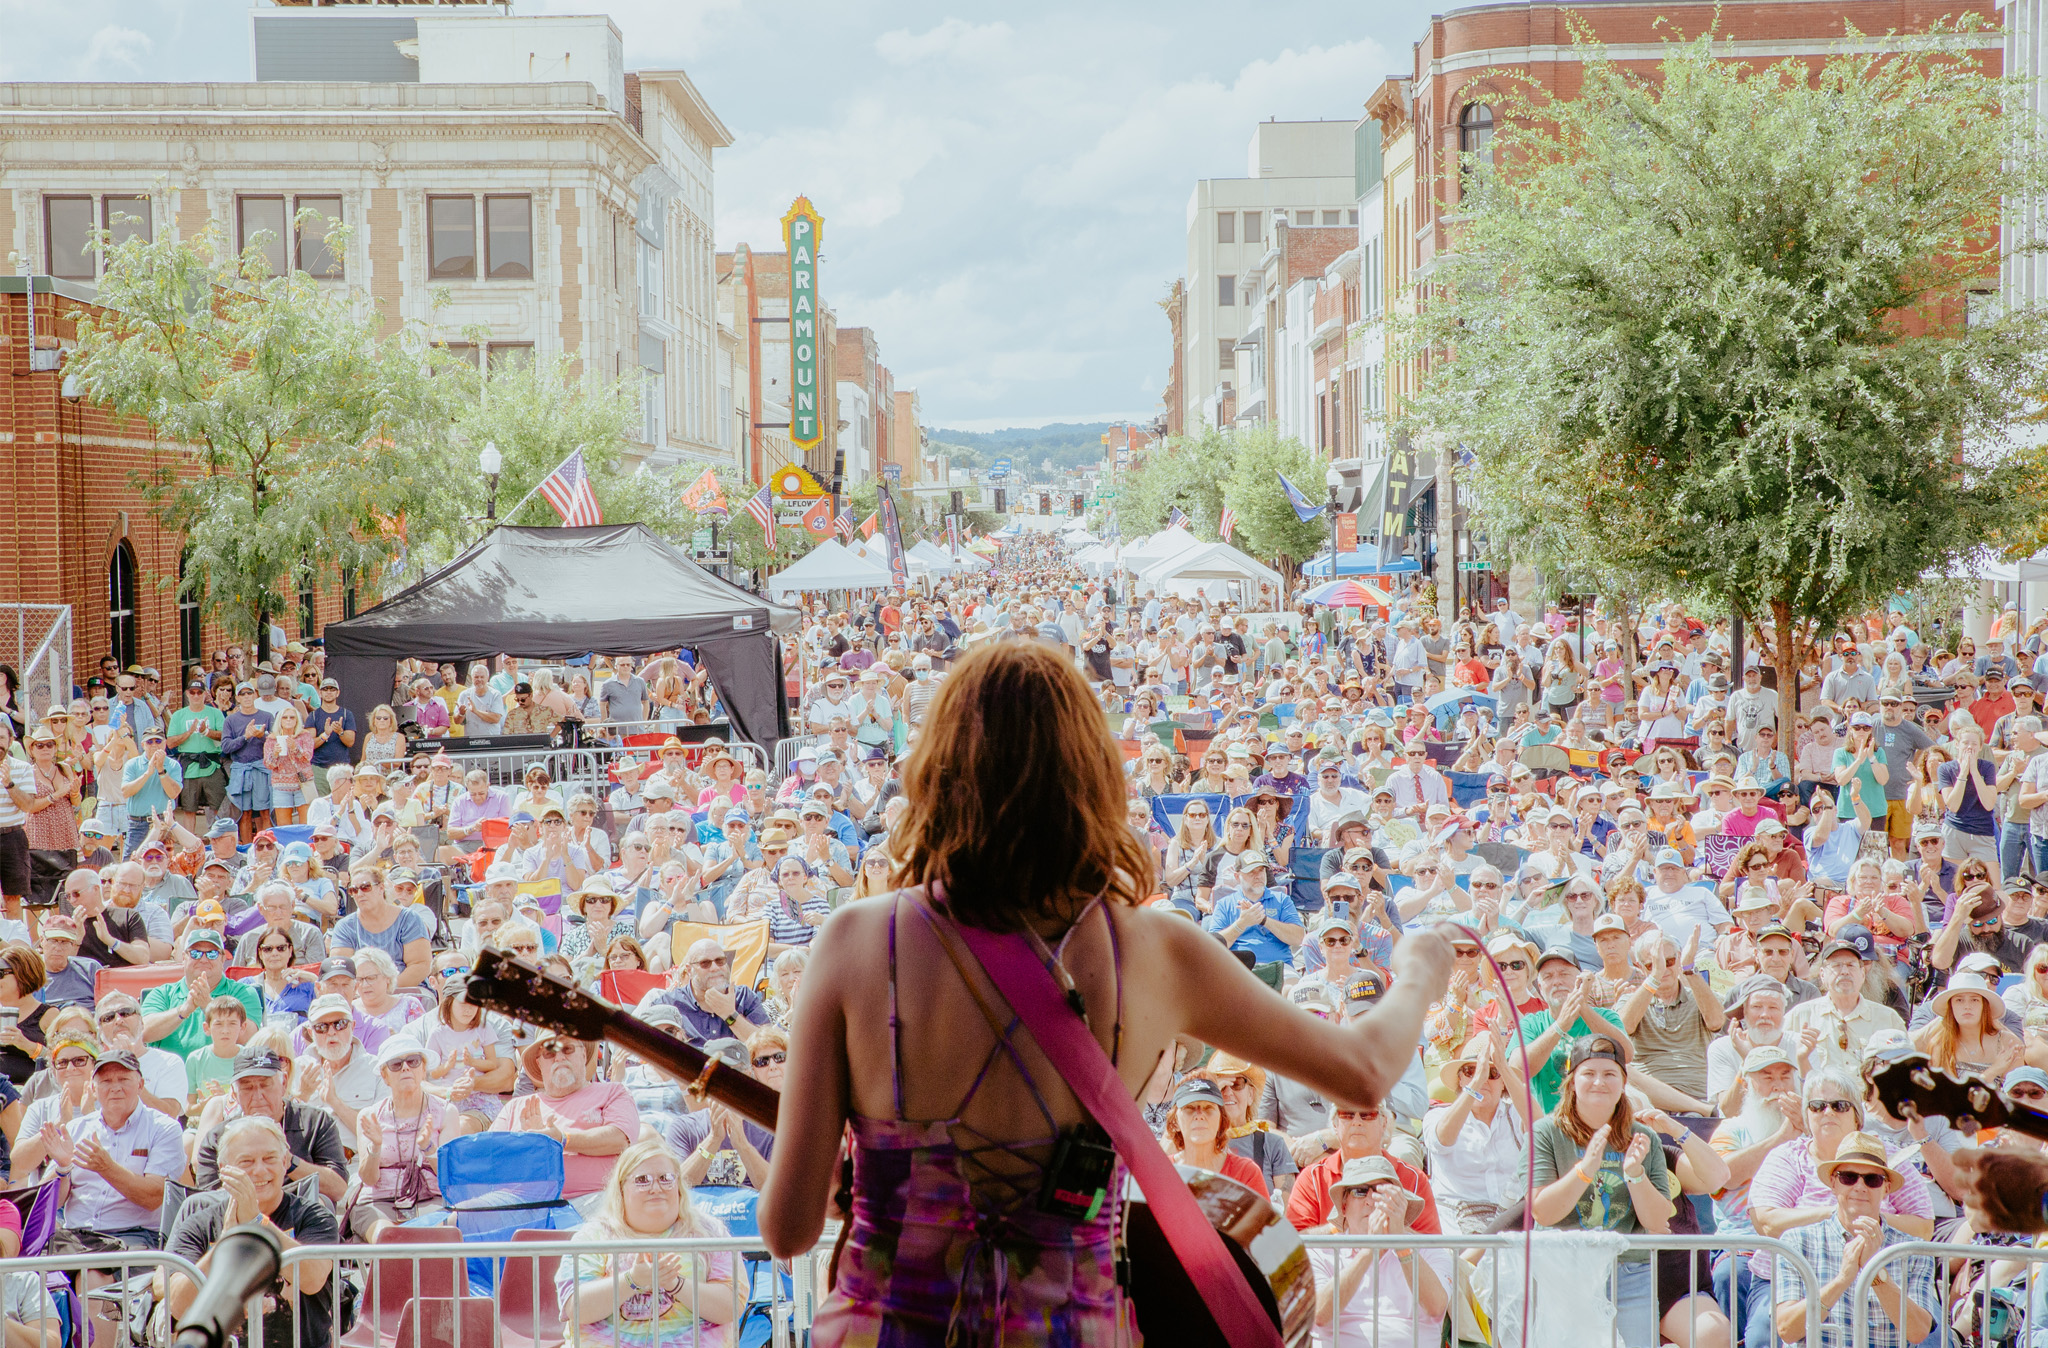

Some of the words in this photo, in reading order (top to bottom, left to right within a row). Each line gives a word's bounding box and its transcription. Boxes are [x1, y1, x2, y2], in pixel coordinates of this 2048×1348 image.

[794, 221, 814, 435] PARAMOUNT
[1384, 450, 1408, 537] ATM
[1363, 579, 1378, 587] ATM
[1350, 981, 1373, 989] KOREA
[1351, 990, 1376, 999] VETERAN
